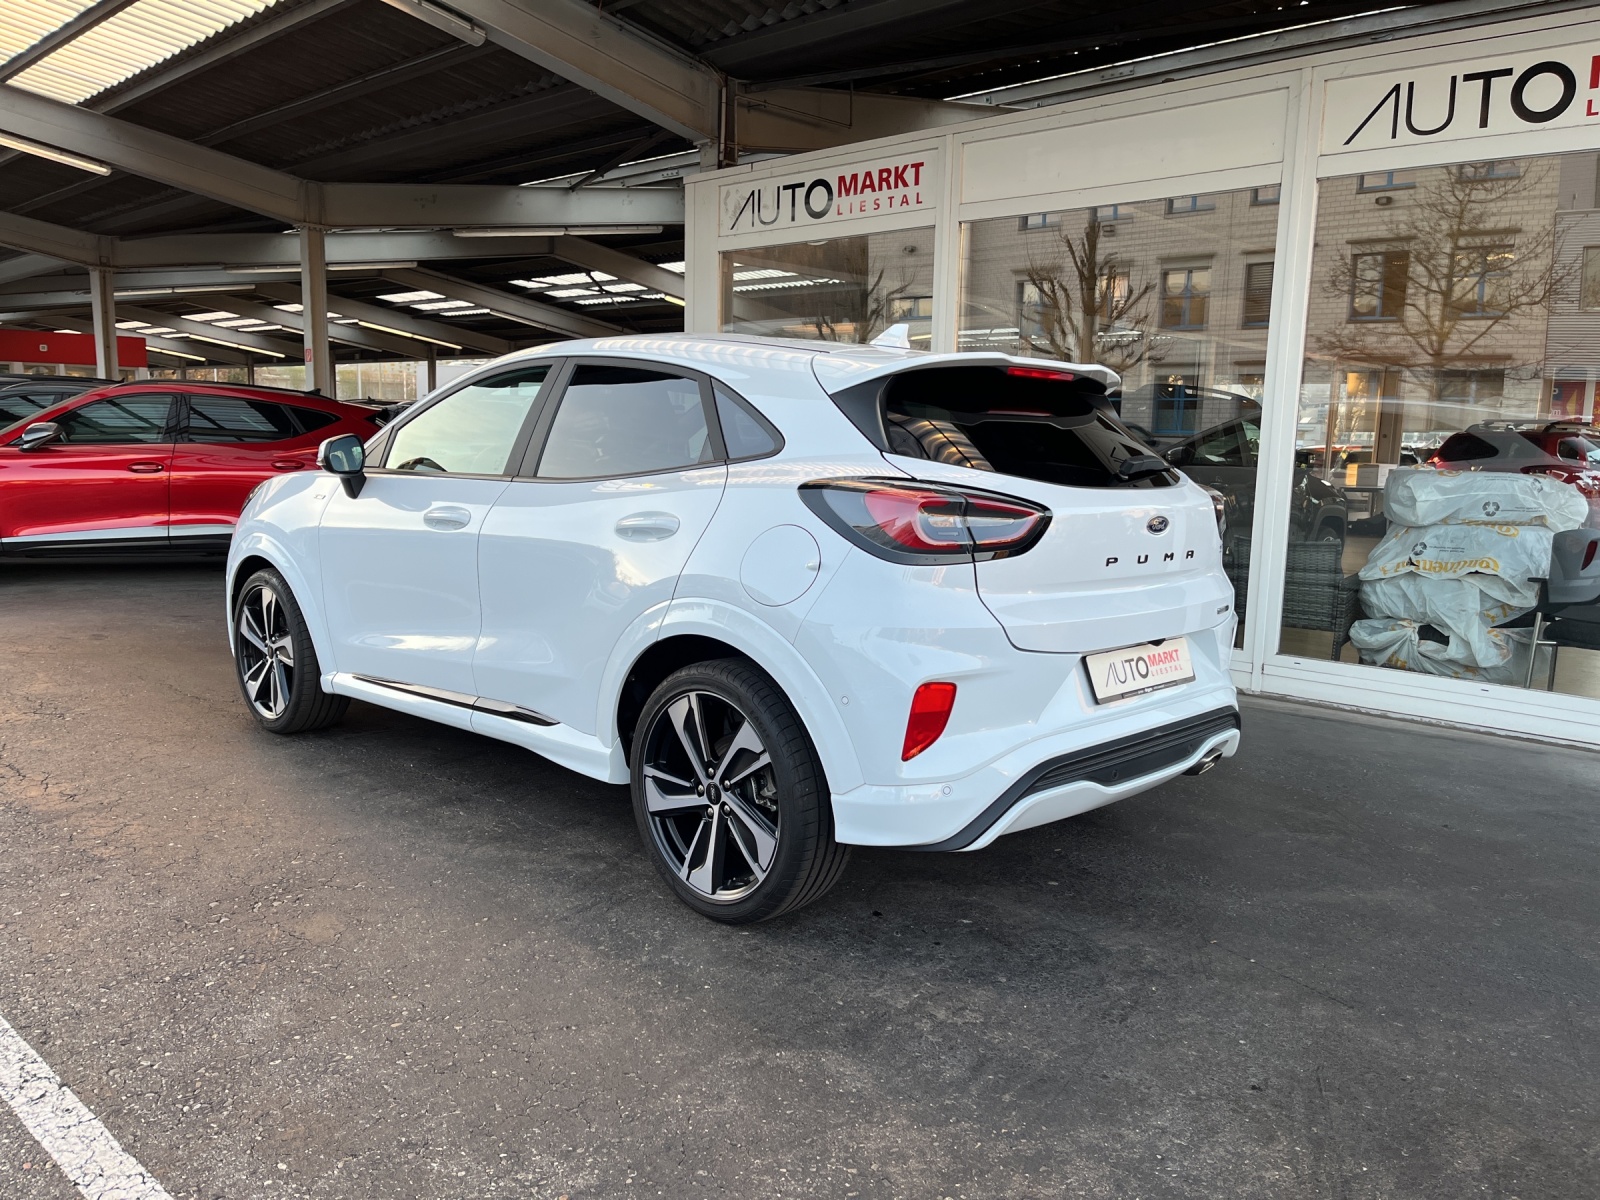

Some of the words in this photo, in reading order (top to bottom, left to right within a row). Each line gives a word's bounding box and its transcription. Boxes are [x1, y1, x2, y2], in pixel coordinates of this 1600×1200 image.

[1343, 60, 1577, 146] AUTO
[730, 178, 834, 231] AUTO
[837, 162, 924, 198] MARKT
[837, 192, 923, 216] LIESTAL
[1105, 550, 1195, 567] PUMA
[1106, 656, 1150, 688] AUTO
[1147, 649, 1180, 667] MARKT
[1150, 664, 1183, 677] LIESTAL
